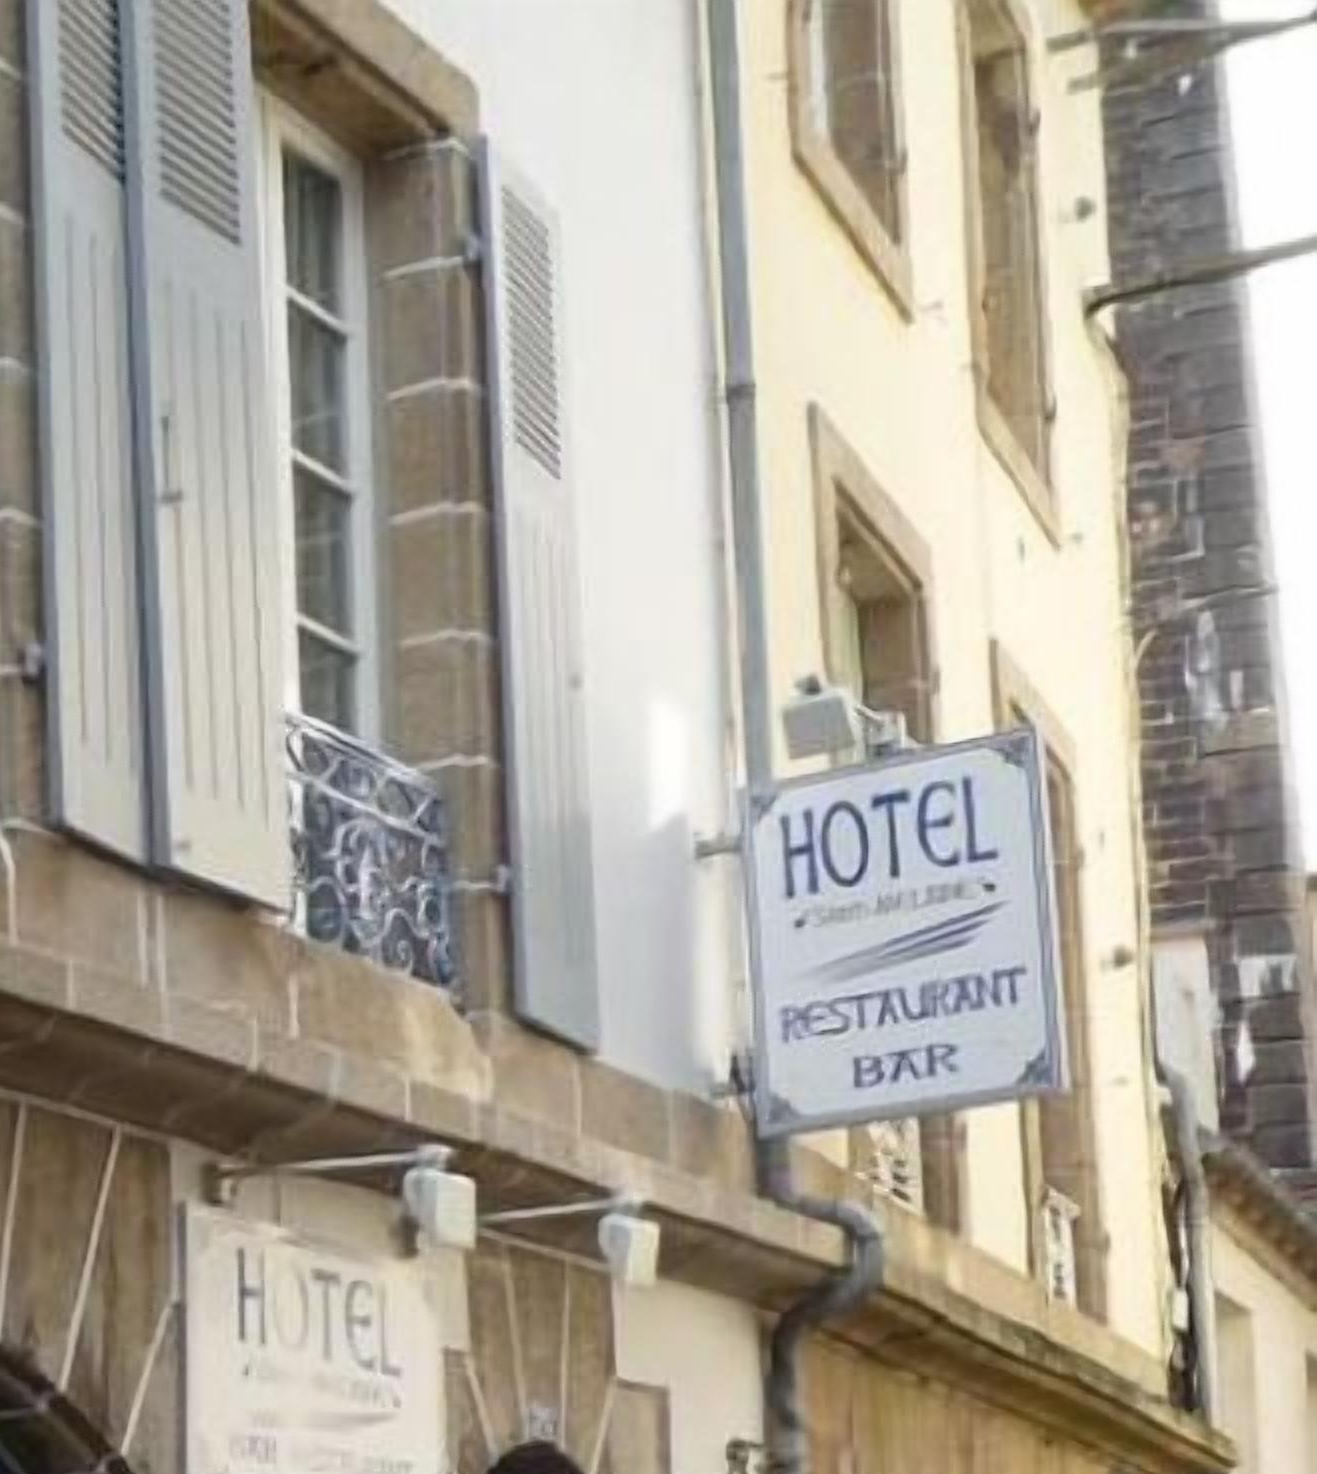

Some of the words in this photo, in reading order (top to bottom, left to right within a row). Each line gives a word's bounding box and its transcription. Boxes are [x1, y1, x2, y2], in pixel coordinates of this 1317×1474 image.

[780, 777, 998, 898] HOTEL
[780, 967, 1027, 1043] RESTAURANT
[853, 1043, 959, 1089] BAR
[237, 1247, 401, 1376] HOTEL
